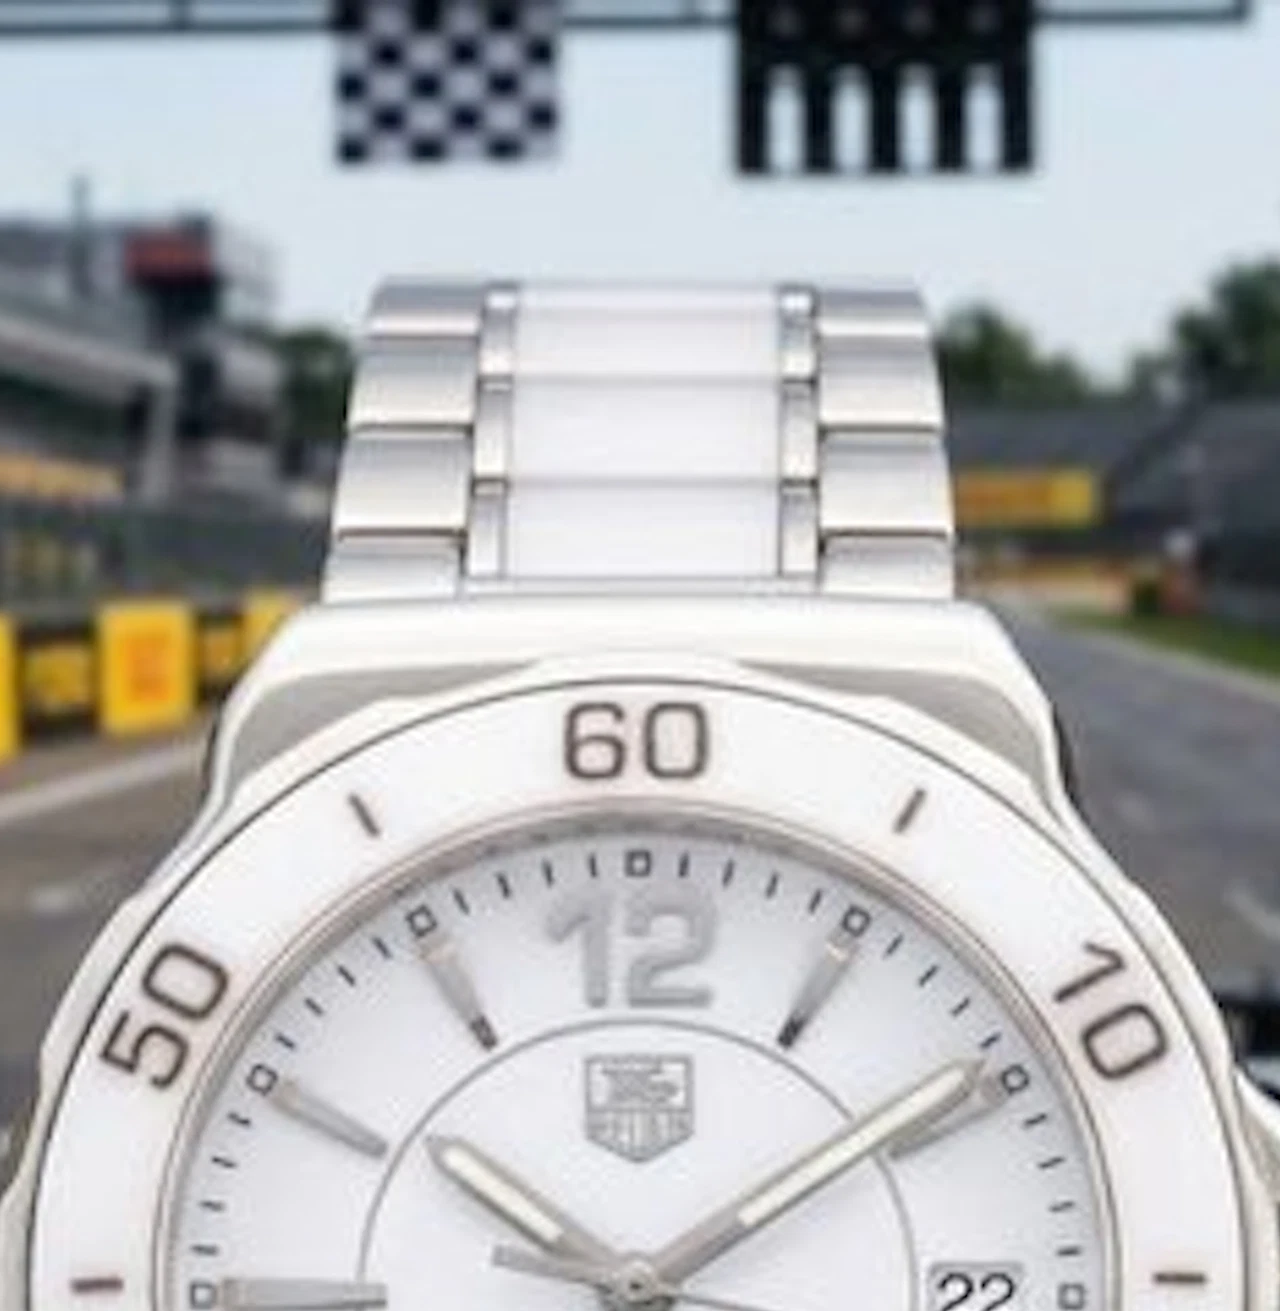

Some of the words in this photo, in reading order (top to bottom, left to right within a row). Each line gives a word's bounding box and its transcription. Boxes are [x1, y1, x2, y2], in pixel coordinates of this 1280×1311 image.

[563, 702, 709, 782] 60
[98, 940, 231, 1090] 50
[543, 890, 720, 1010] 12
[1053, 939, 1170, 1082] 10
